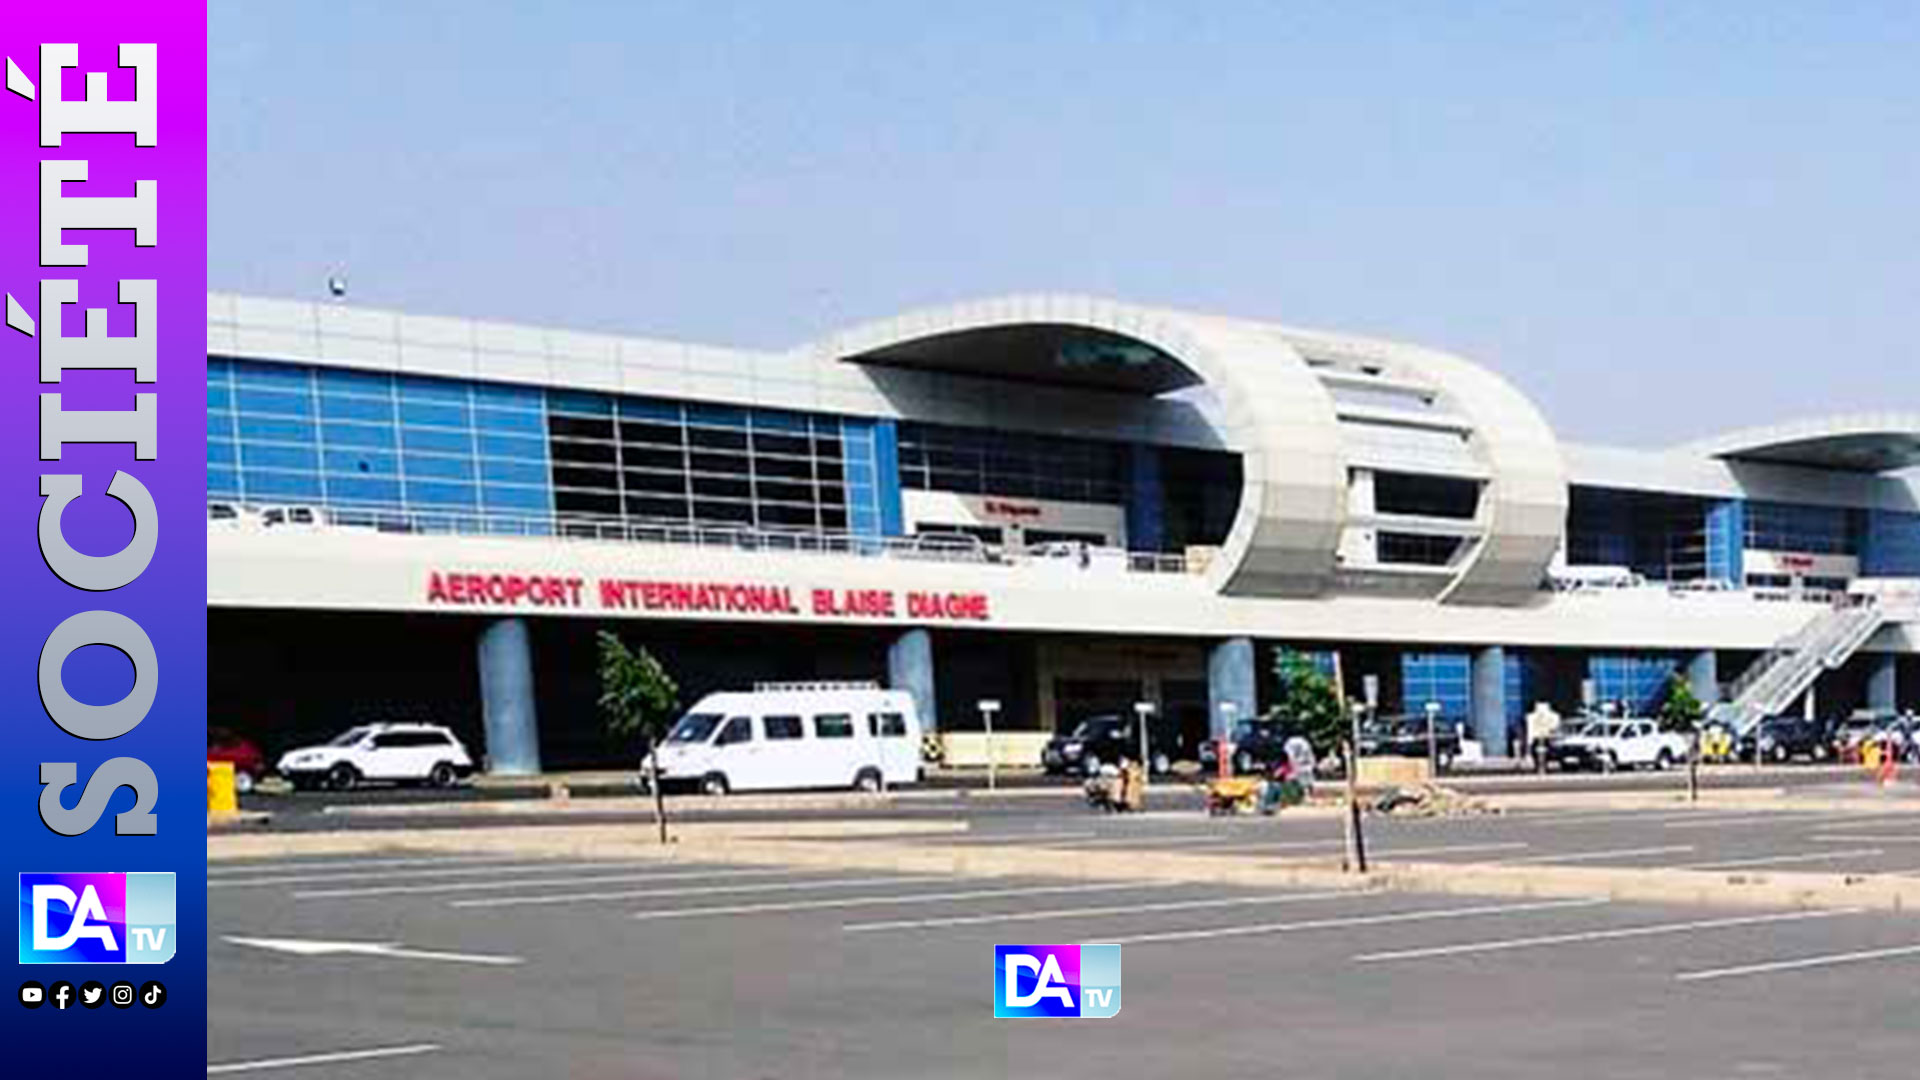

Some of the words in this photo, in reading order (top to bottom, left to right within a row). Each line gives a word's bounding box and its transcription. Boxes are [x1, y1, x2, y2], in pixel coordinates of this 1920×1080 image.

[427, 573, 583, 606] AEROPORT
[599, 578, 799, 614] INTERNATIONAL
[811, 589, 895, 617] BLAISE
[906, 592, 990, 620] DIAGNE
